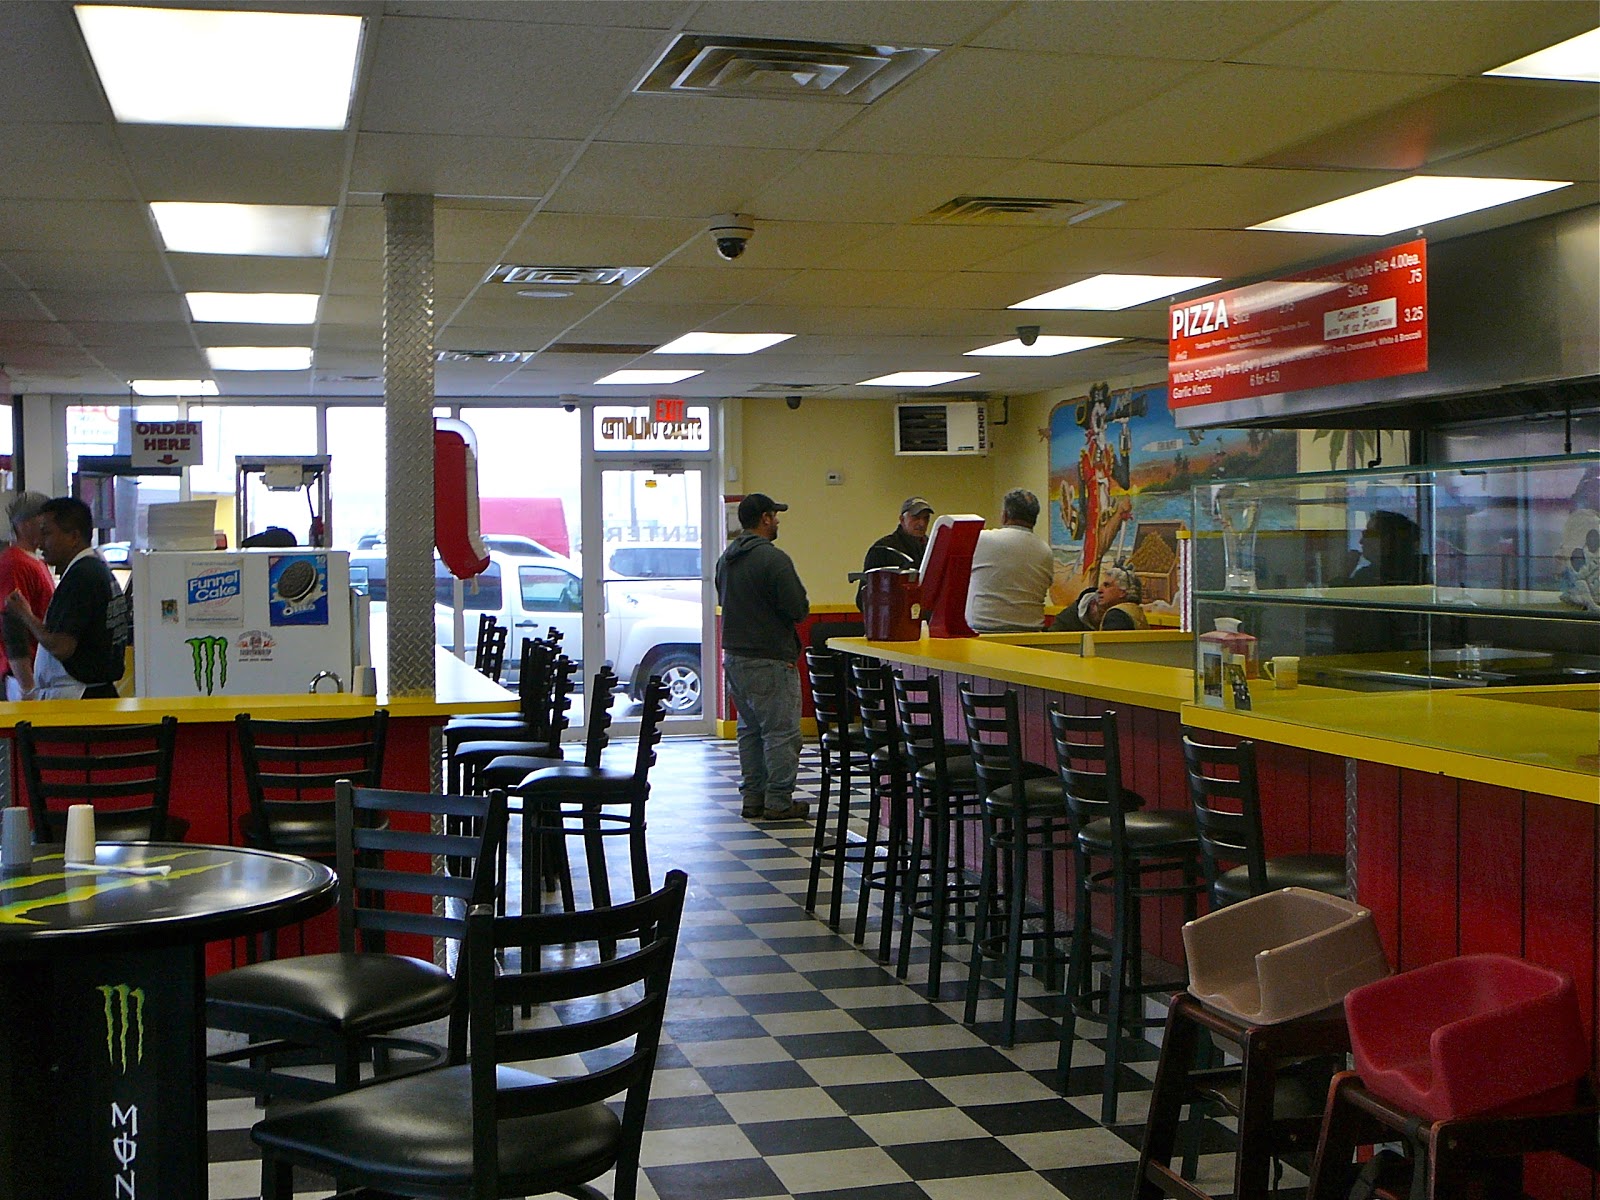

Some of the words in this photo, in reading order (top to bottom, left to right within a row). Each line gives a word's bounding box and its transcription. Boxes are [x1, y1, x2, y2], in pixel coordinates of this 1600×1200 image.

[1345, 264, 1372, 282] Whole
[1374, 260, 1389, 275] Pie
[1408, 269, 1422, 285] .75
[1348, 282, 1368, 298] Slice
[1172, 298, 1229, 340] PIZZA
[1404, 305, 1424, 322] 3.25
[1172, 364, 1195, 385] Whole
[1194, 359, 1225, 382] Specialty
[1225, 358, 1242, 375] Pies
[1378, 335, 1394, 347] White
[1399, 330, 1422, 342] Broccoli
[1172, 385, 1193, 400] Garlic
[1193, 382, 1213, 396] Knots
[656, 399, 685, 422] EXIT
[135, 422, 198, 435] ORDER
[978, 407, 986, 449] REZNOR
[144, 438, 191, 451] HERE
[189, 571, 238, 591] Funnel
[195, 586, 237, 602] Cake
